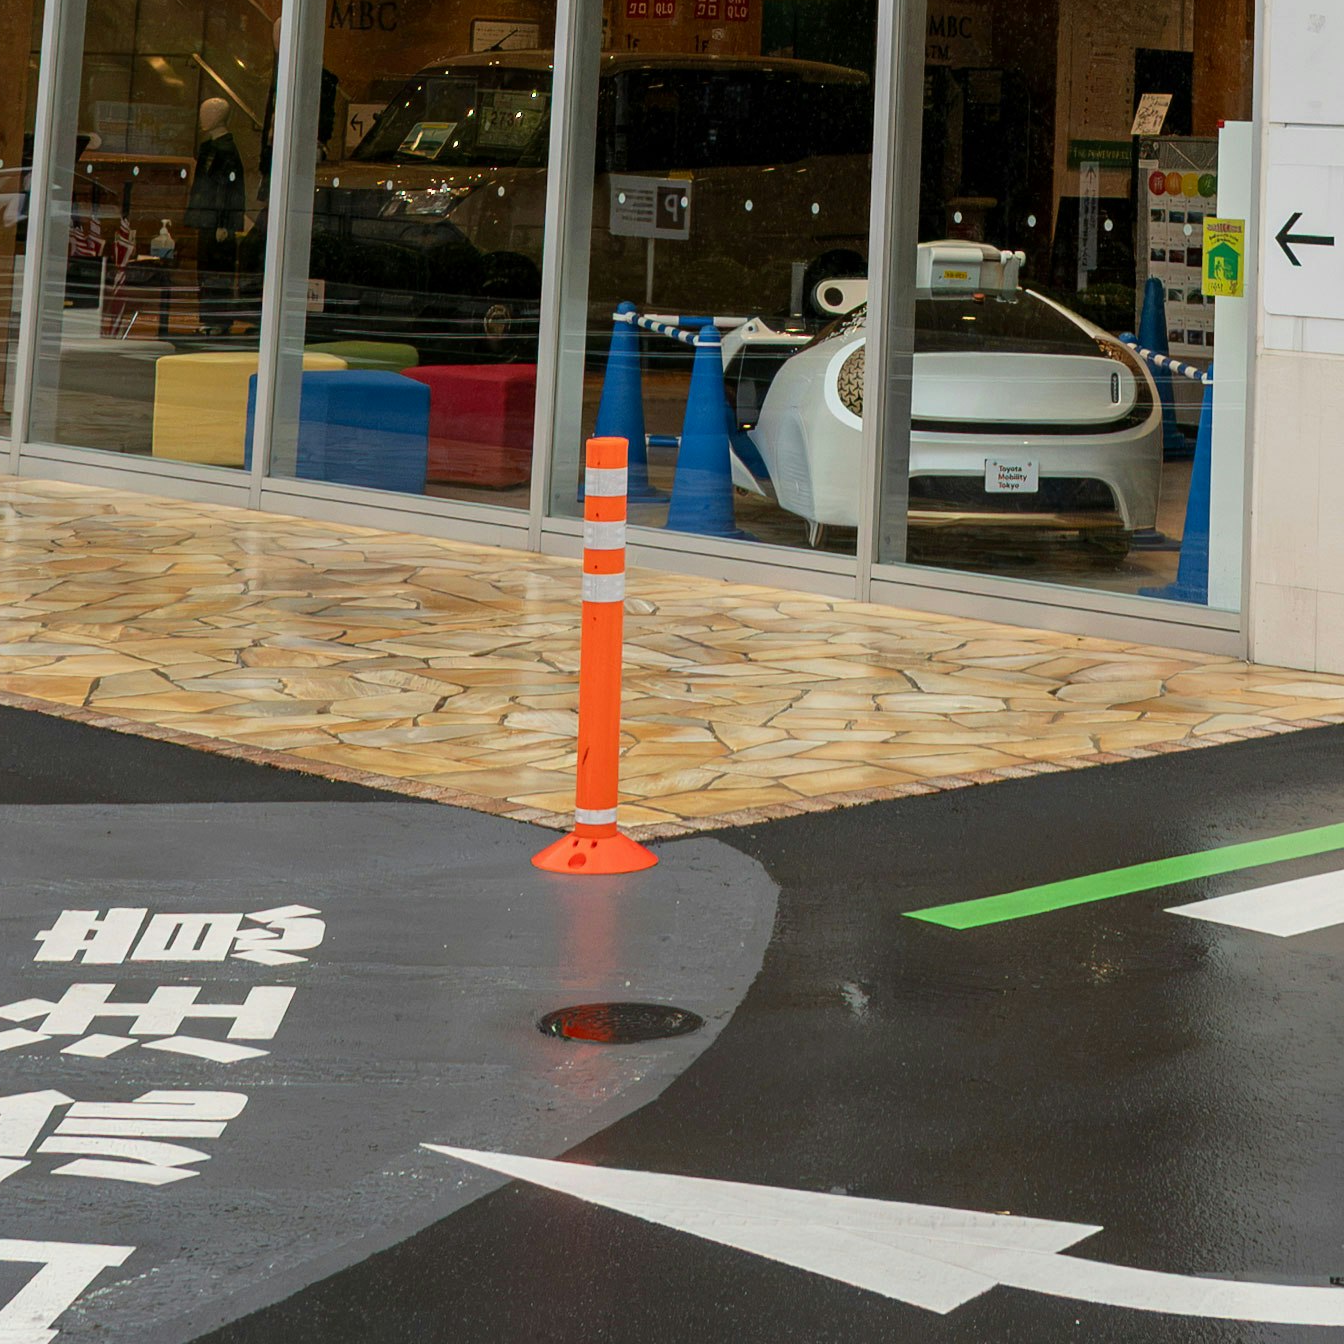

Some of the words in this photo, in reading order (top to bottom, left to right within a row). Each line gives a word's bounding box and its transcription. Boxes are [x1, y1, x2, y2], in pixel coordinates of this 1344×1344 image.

[328, 0, 398, 32] MBC
[656, 4, 674, 17] QLO
[727, 5, 747, 19] QLO
[928, 16, 973, 39] MBC
[627, 33, 641, 51] 1F
[695, 34, 709, 52] 1F
[998, 465, 1023, 473] Toyota
[998, 473, 1027, 482] Mobility
[998, 482, 1020, 490] Tokyo
